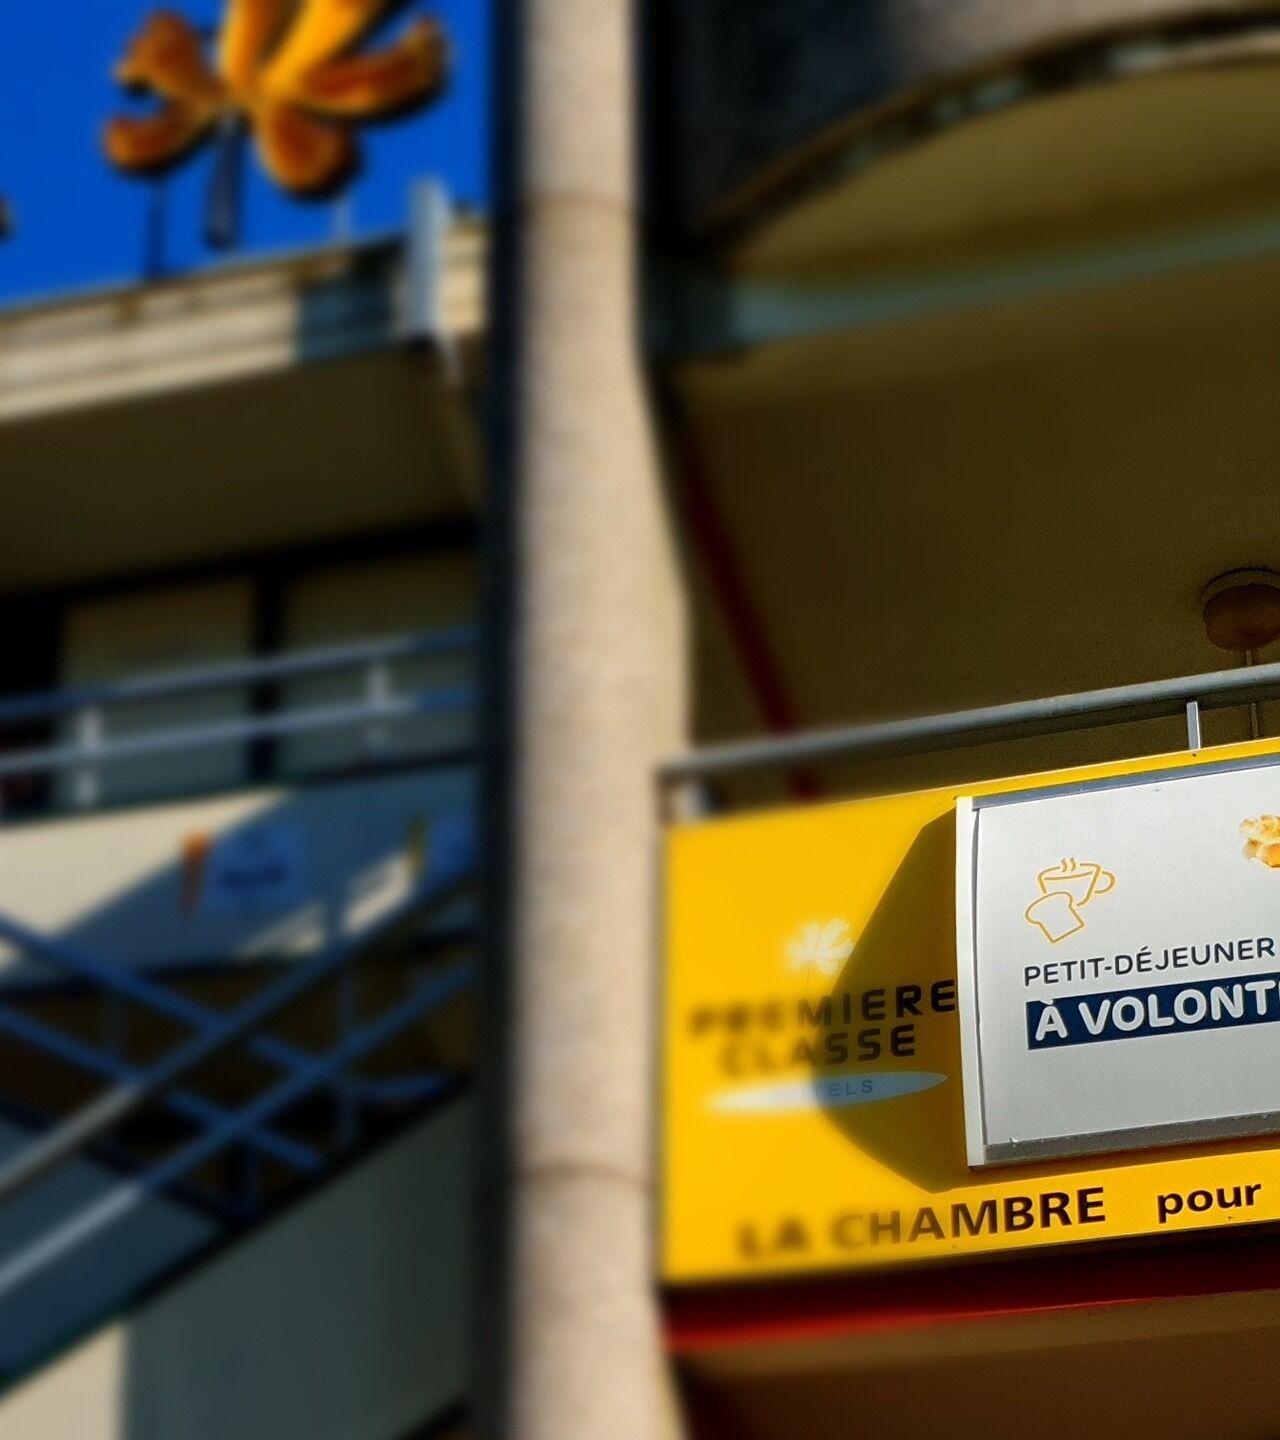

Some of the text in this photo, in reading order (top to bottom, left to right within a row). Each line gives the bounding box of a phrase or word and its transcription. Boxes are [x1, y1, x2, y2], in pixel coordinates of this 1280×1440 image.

[1024, 936, 1276, 987] PETIT-DÉJEUNER
[1034, 998, 1069, 1042] À
[828, 1186, 1107, 1249] CHAMBRE
[1157, 1183, 1262, 1224] pour
